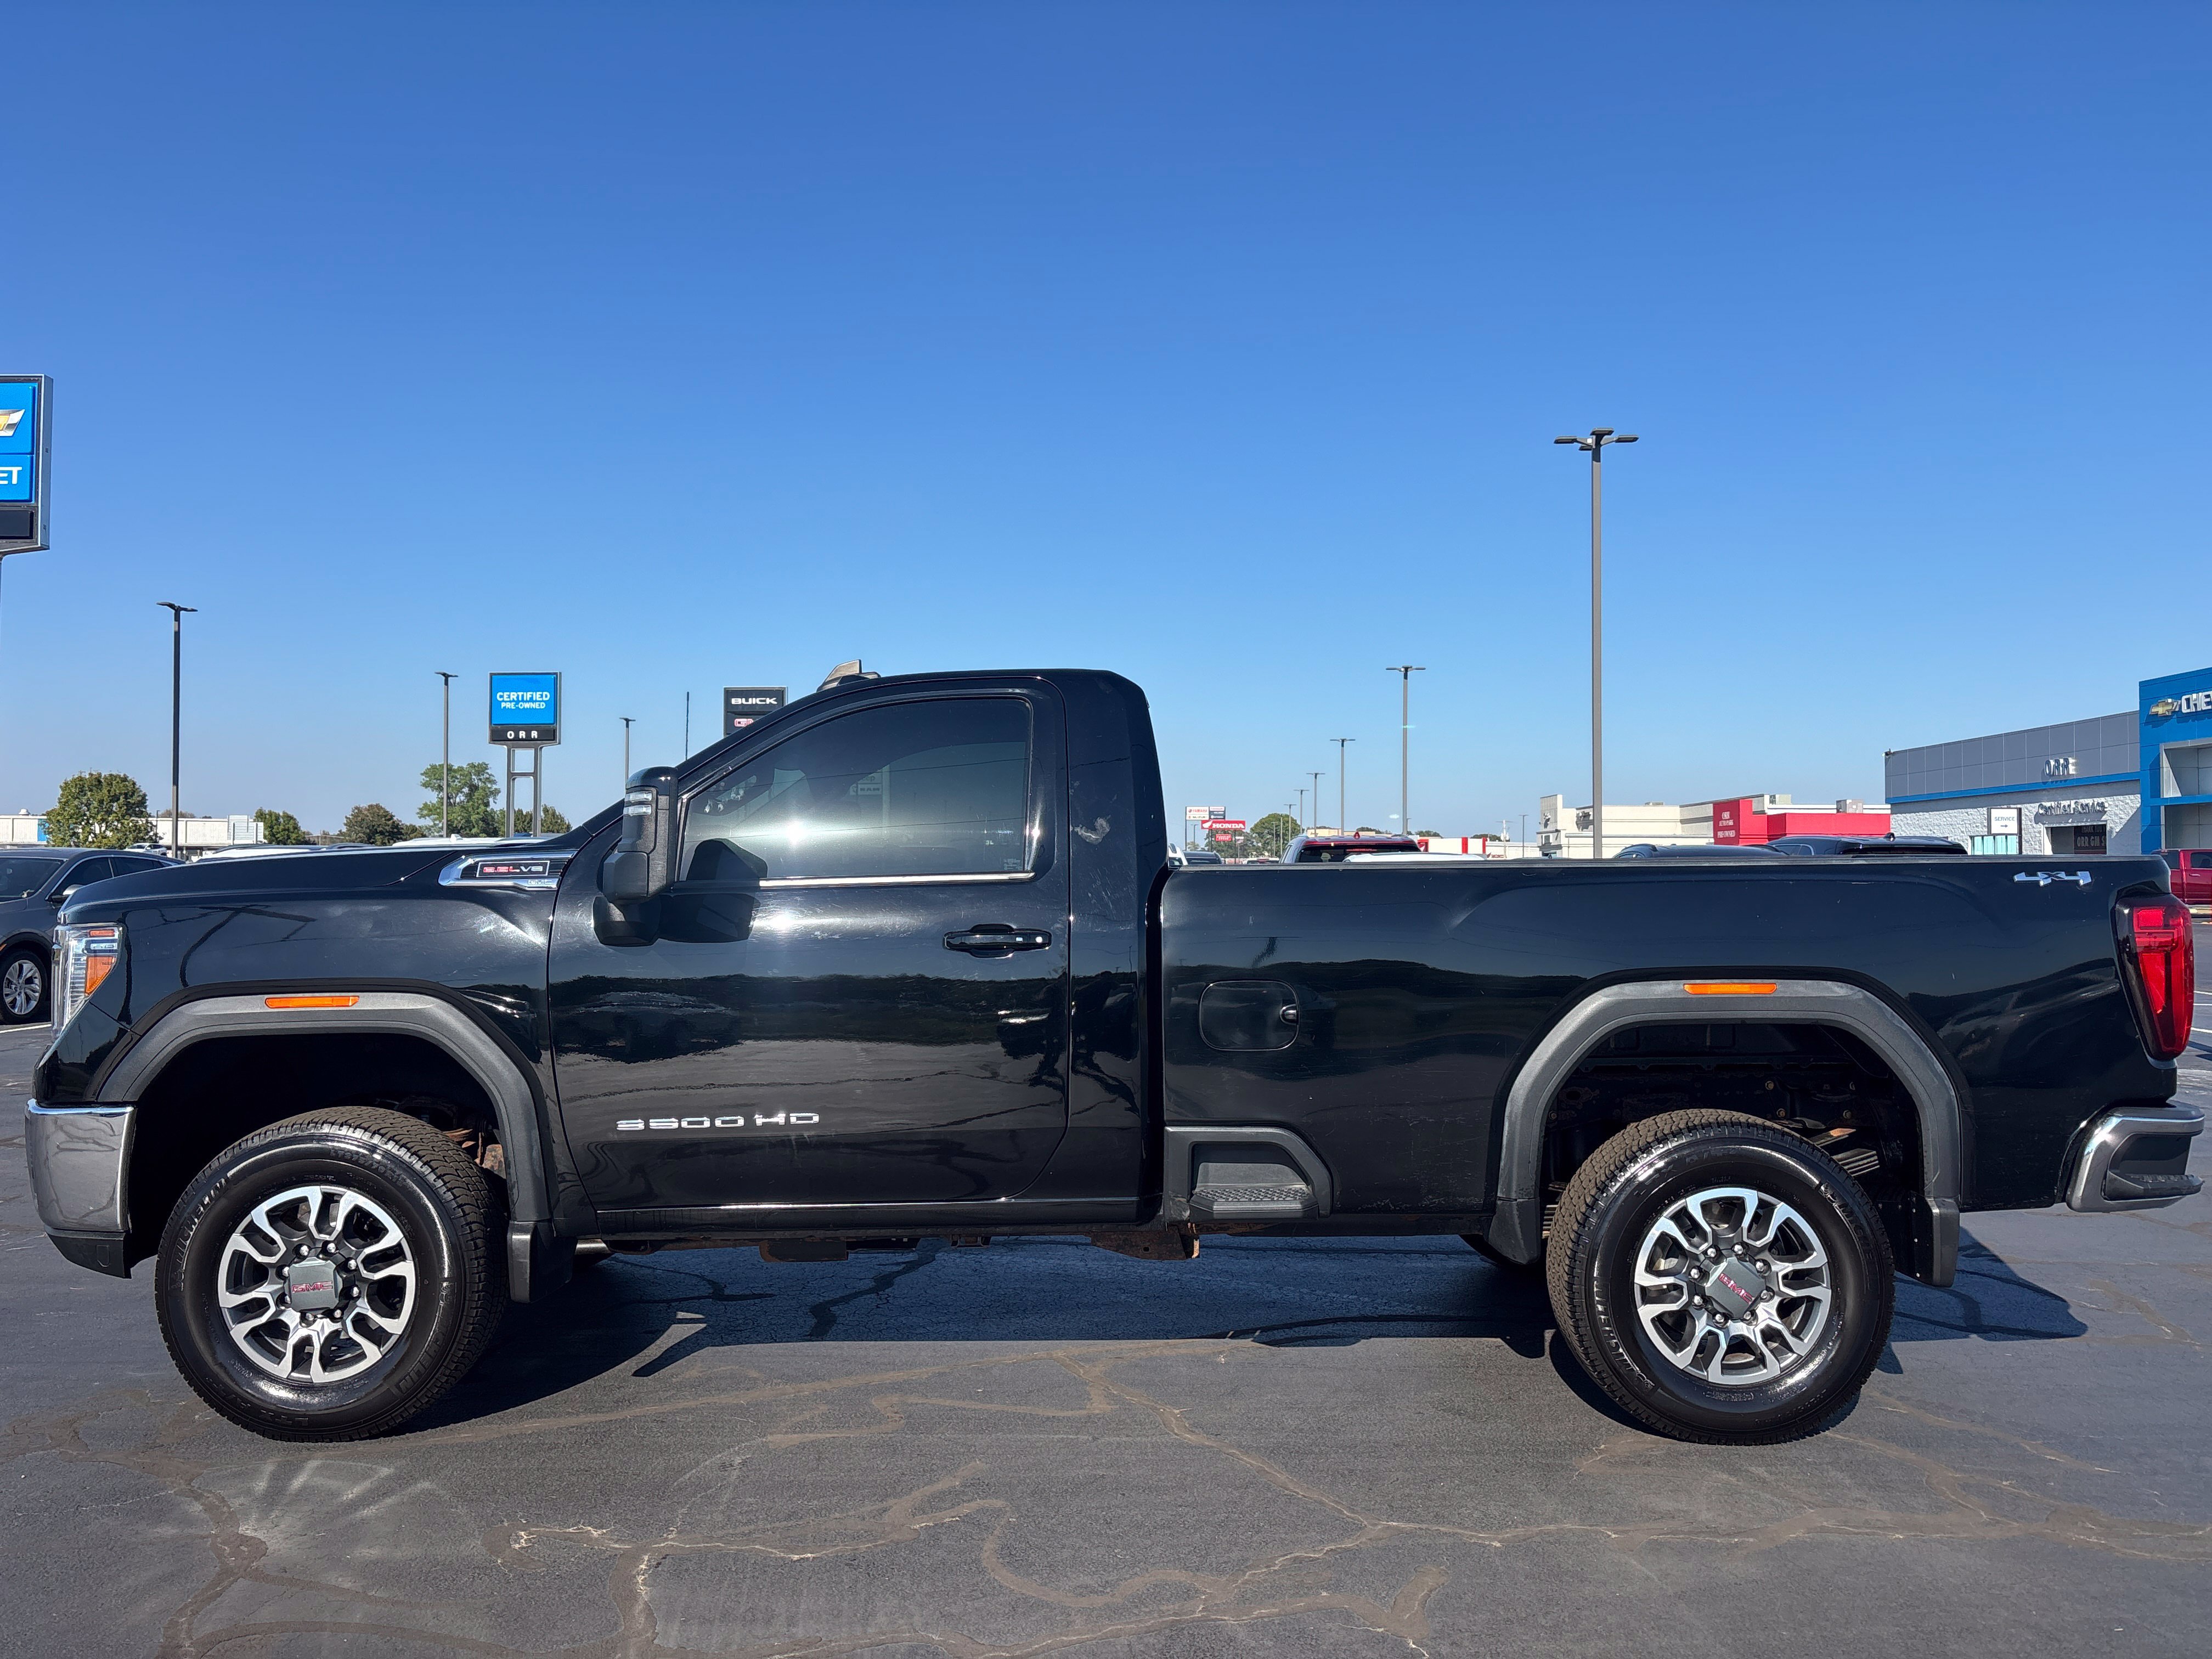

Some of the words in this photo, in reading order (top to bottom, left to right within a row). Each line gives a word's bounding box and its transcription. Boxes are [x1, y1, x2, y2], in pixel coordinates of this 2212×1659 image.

[496, 692, 550, 701] CERTIFIED
[507, 731, 538, 739] ORR
[2045, 757, 2073, 777] ORR
[2038, 800, 2072, 815] Certified
[2074, 800, 2107, 815] Service
[2077, 836, 2089, 847] ORR
[754, 1113, 819, 1126] HD
[291, 1280, 334, 1294] GMC
[1718, 1273, 1755, 1304] GMC
